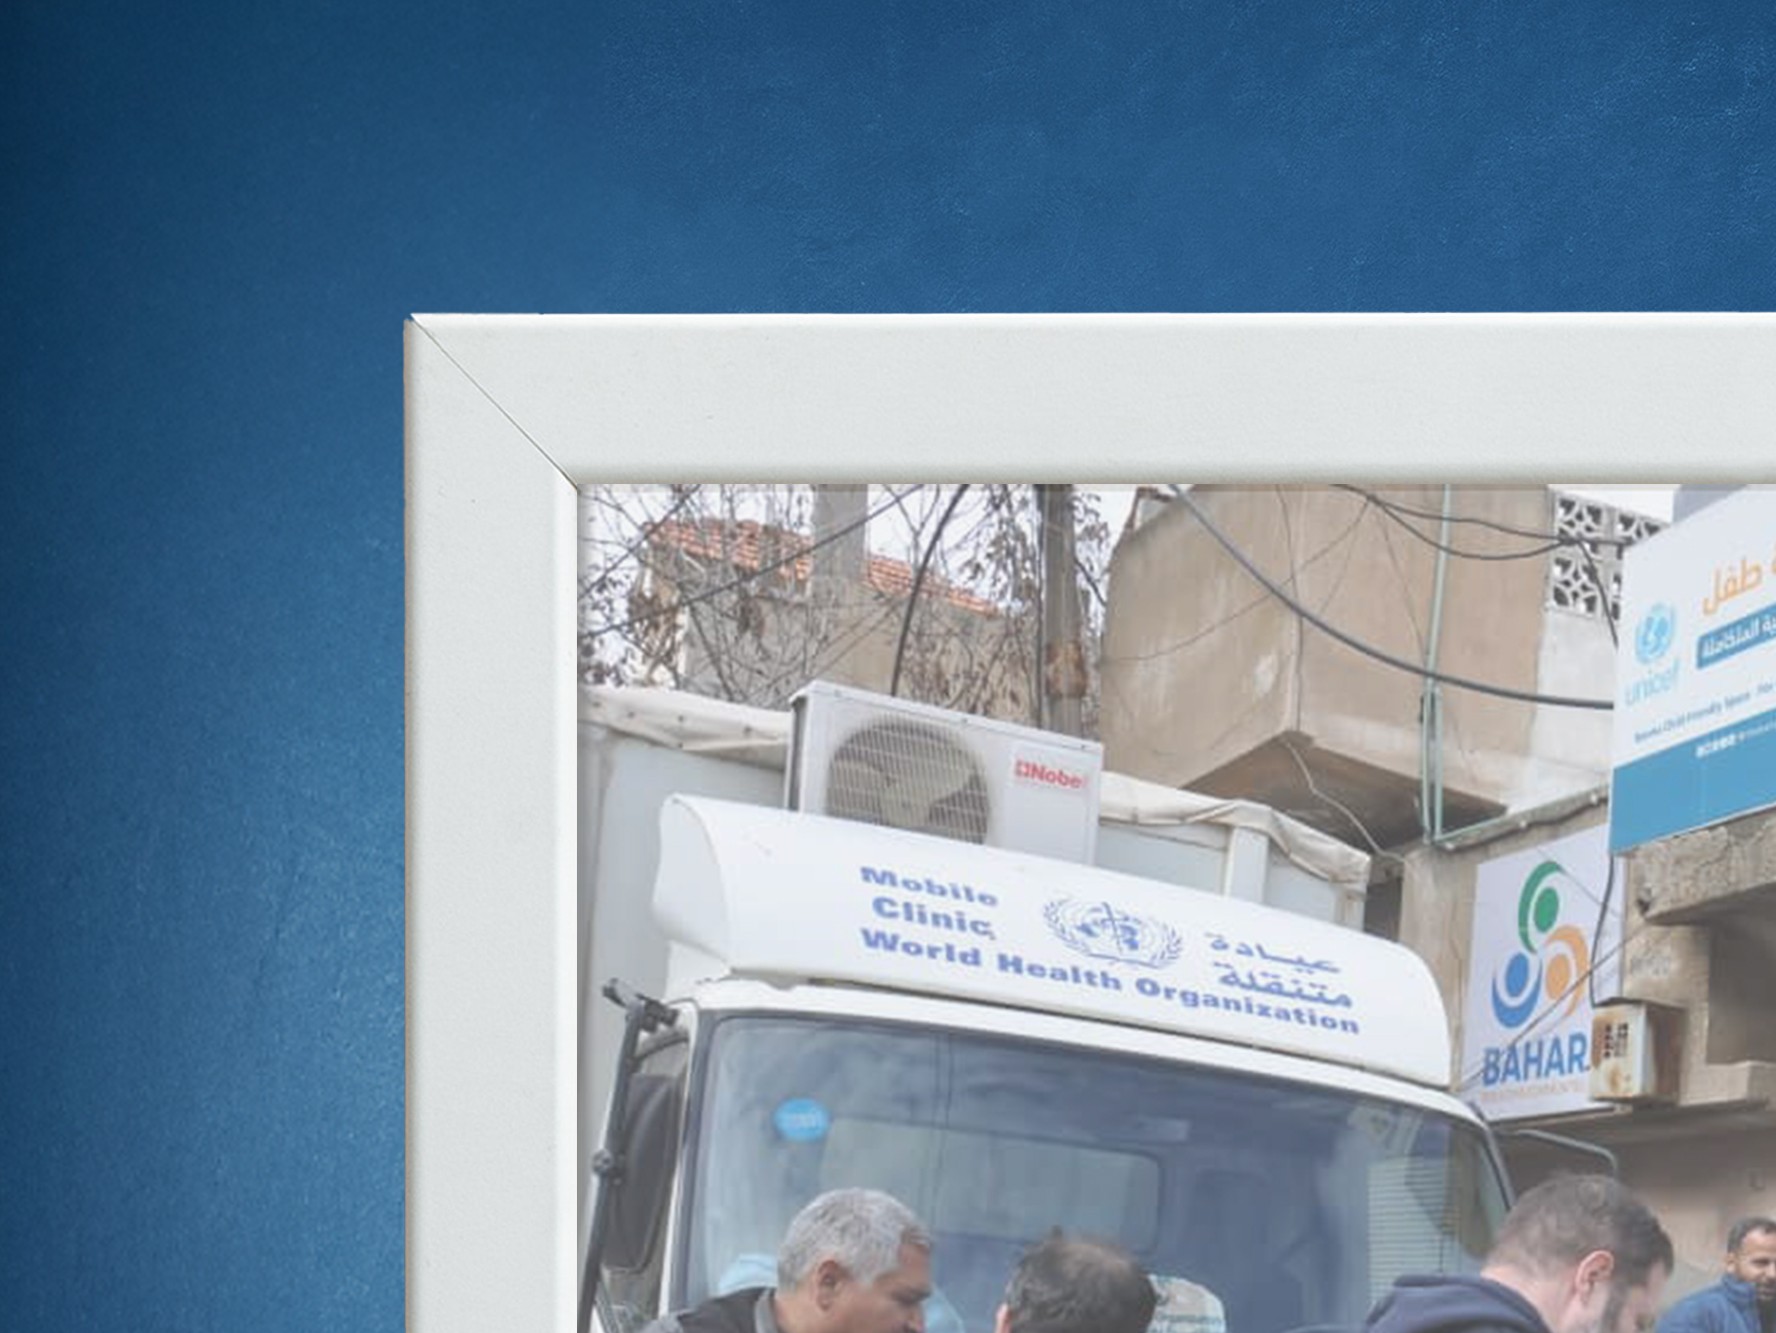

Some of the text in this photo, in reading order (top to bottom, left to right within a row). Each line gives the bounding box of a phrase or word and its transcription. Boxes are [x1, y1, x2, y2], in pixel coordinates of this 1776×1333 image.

[1703, 559, 1763, 615] طفل
[860, 866, 998, 907] Mobile
[872, 896, 990, 936] Clinic
[860, 928, 1360, 1034] World Health Organization
[1214, 961, 1353, 1007] متنقلة
[1482, 1031, 1587, 1086] BAHAR
